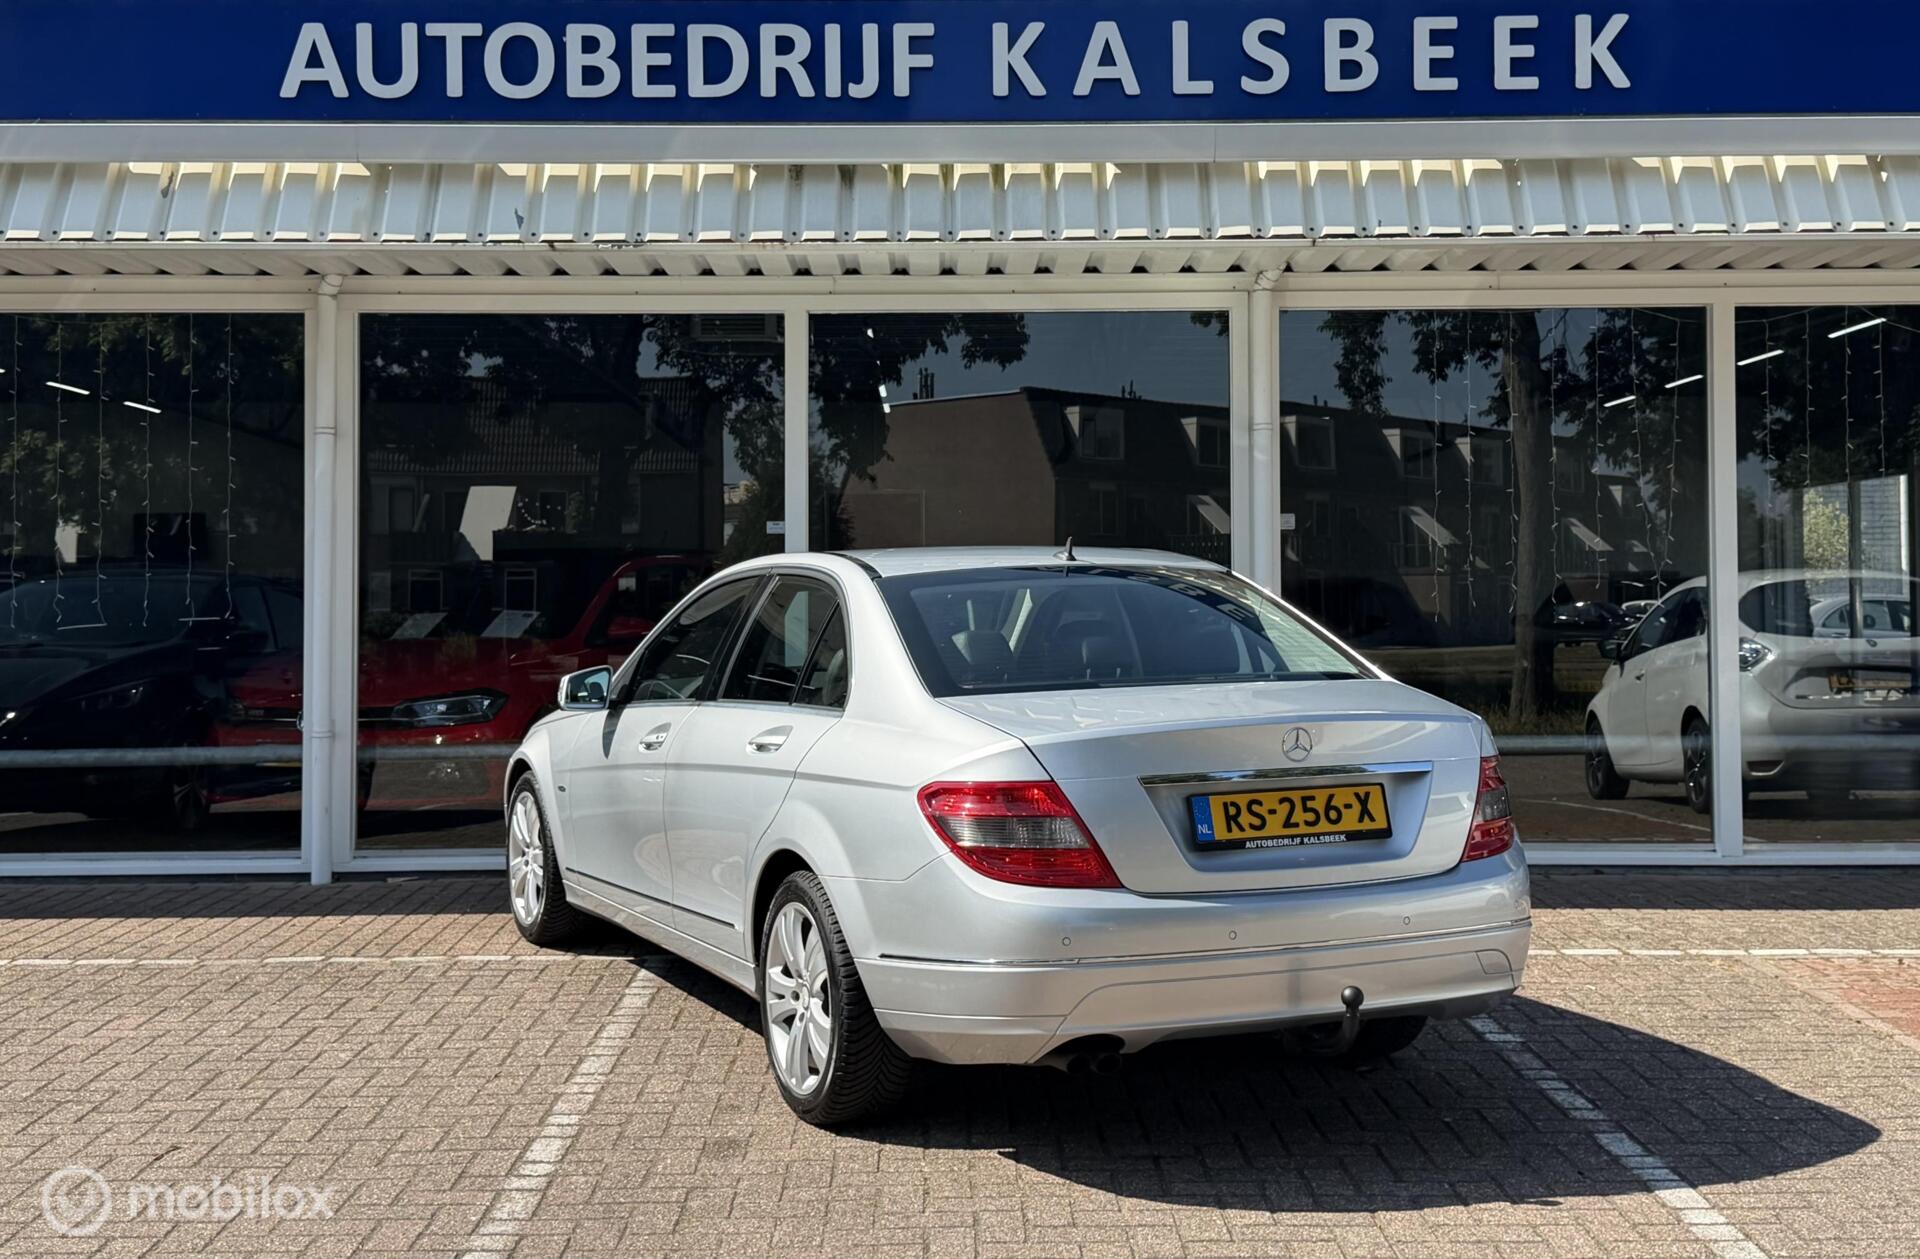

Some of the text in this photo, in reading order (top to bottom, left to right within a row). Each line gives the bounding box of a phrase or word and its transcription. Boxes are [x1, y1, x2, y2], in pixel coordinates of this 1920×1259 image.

[279, 13, 1631, 98] AUTOBEDRIJF KALSBEEK
[1222, 791, 1376, 833] RS-256-X
[1198, 824, 1212, 834] NL
[1245, 834, 1347, 848] AUTOBEDRIJF KALSBEEK
